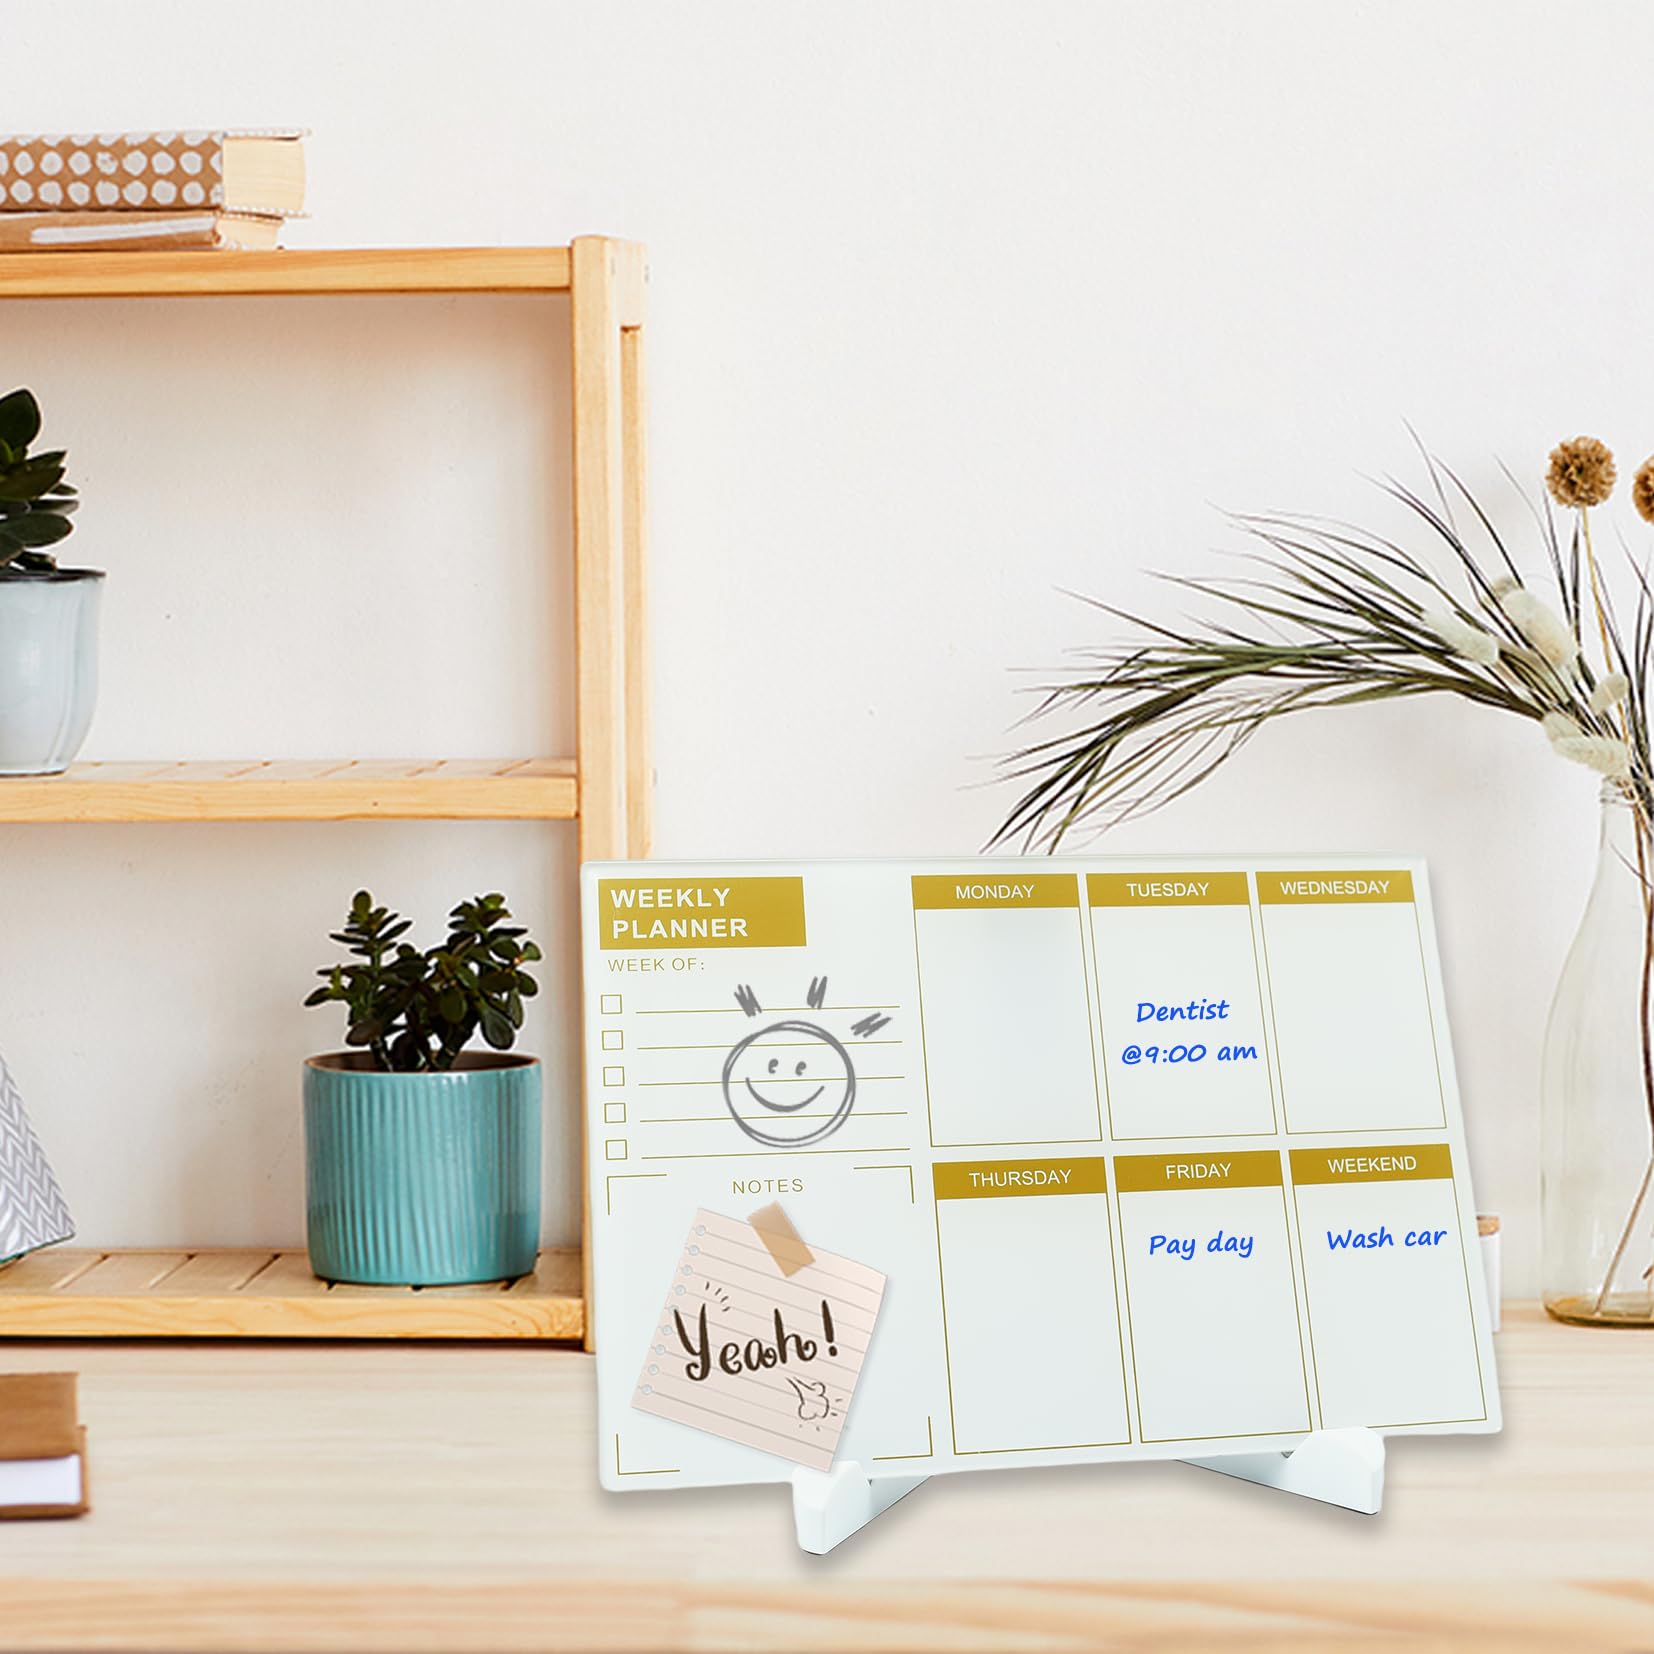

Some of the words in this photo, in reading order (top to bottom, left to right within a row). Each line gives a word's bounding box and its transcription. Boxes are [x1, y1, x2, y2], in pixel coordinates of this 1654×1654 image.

[956, 885, 1034, 899] MONDAY
[1126, 883, 1208, 897] TUESDAY
[1280, 880, 1389, 895] WEDNESDAY
[610, 888, 730, 908] WEEKLY
[613, 918, 748, 939] PLANNER
[607, 958, 666, 973] WEEK
[671, 956, 705, 972] OF:
[1136, 998, 1230, 1023] Dentist
[1121, 1043, 1207, 1065] @9:00
[1217, 1045, 1259, 1062] am
[1166, 1163, 1230, 1179] FRIDAY
[1328, 1156, 1416, 1173] WEEKEND
[732, 1179, 804, 1194] NOTES
[969, 1170, 1071, 1187] THURSDAY
[1149, 1234, 1196, 1261] Pay
[1206, 1231, 1254, 1259] day
[1327, 1225, 1395, 1251] Wash
[1404, 1230, 1448, 1248] car
[674, 1299, 838, 1382] Yeah!
